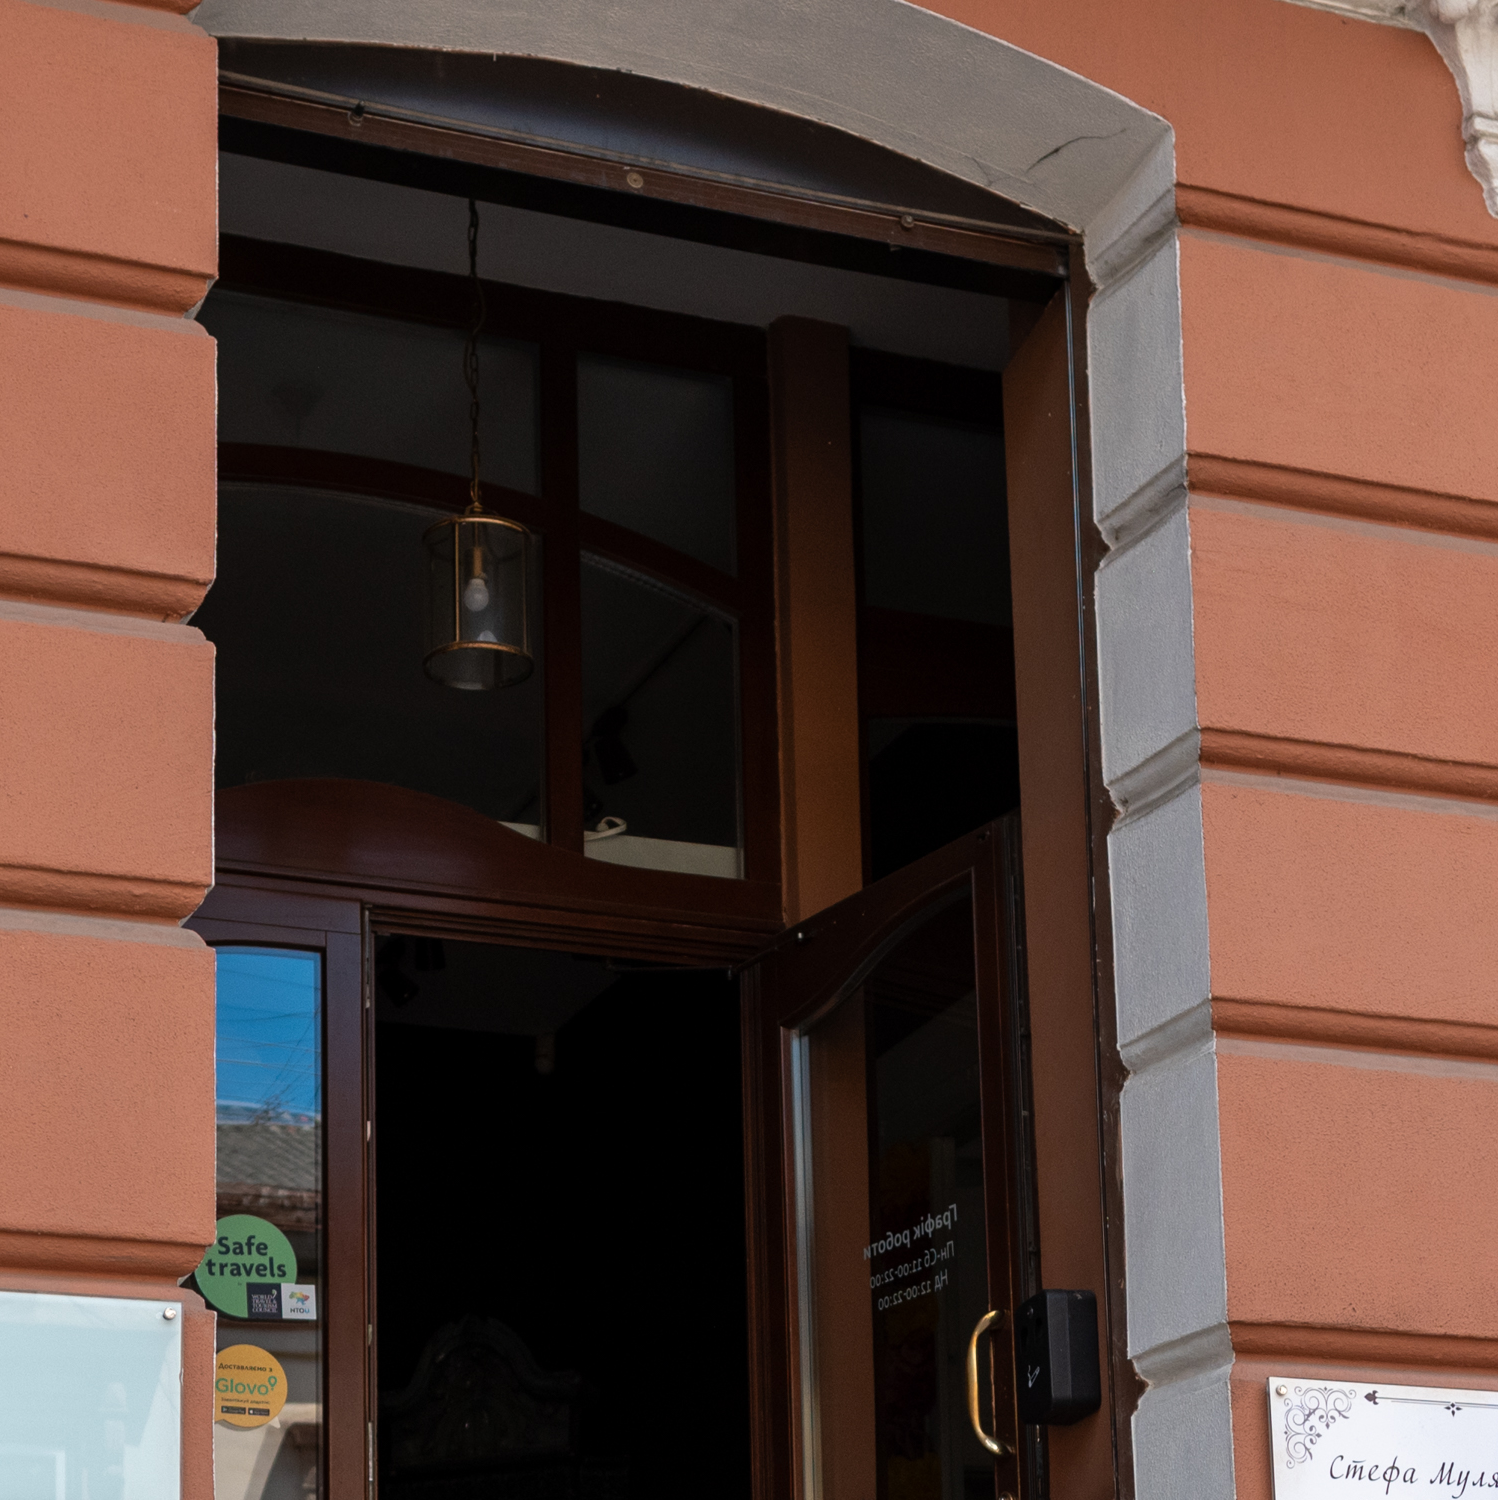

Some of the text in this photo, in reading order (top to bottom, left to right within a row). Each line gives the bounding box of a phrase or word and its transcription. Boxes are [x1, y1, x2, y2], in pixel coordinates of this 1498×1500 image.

[217, 1235, 269, 1256] Safe
[205, 1256, 287, 1278] travels
[215, 1377, 269, 1396] Glovo
[1330, 1455, 1418, 1495] Стефа
